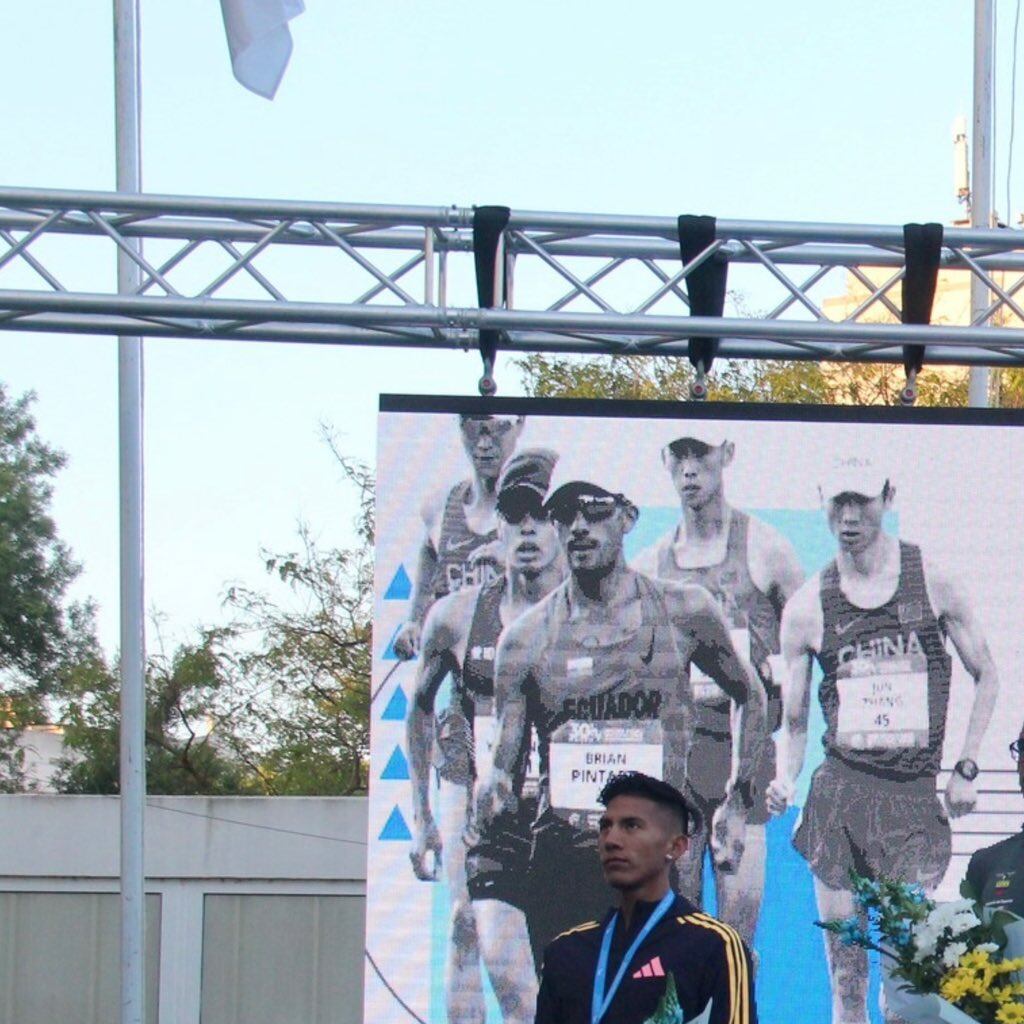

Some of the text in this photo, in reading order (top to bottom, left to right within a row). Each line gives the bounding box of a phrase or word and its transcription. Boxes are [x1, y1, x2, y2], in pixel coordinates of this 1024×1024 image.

[563, 689, 662, 721] ECUADOR
[874, 714, 890, 727] 45
[585, 752, 627, 765] BRIAN
